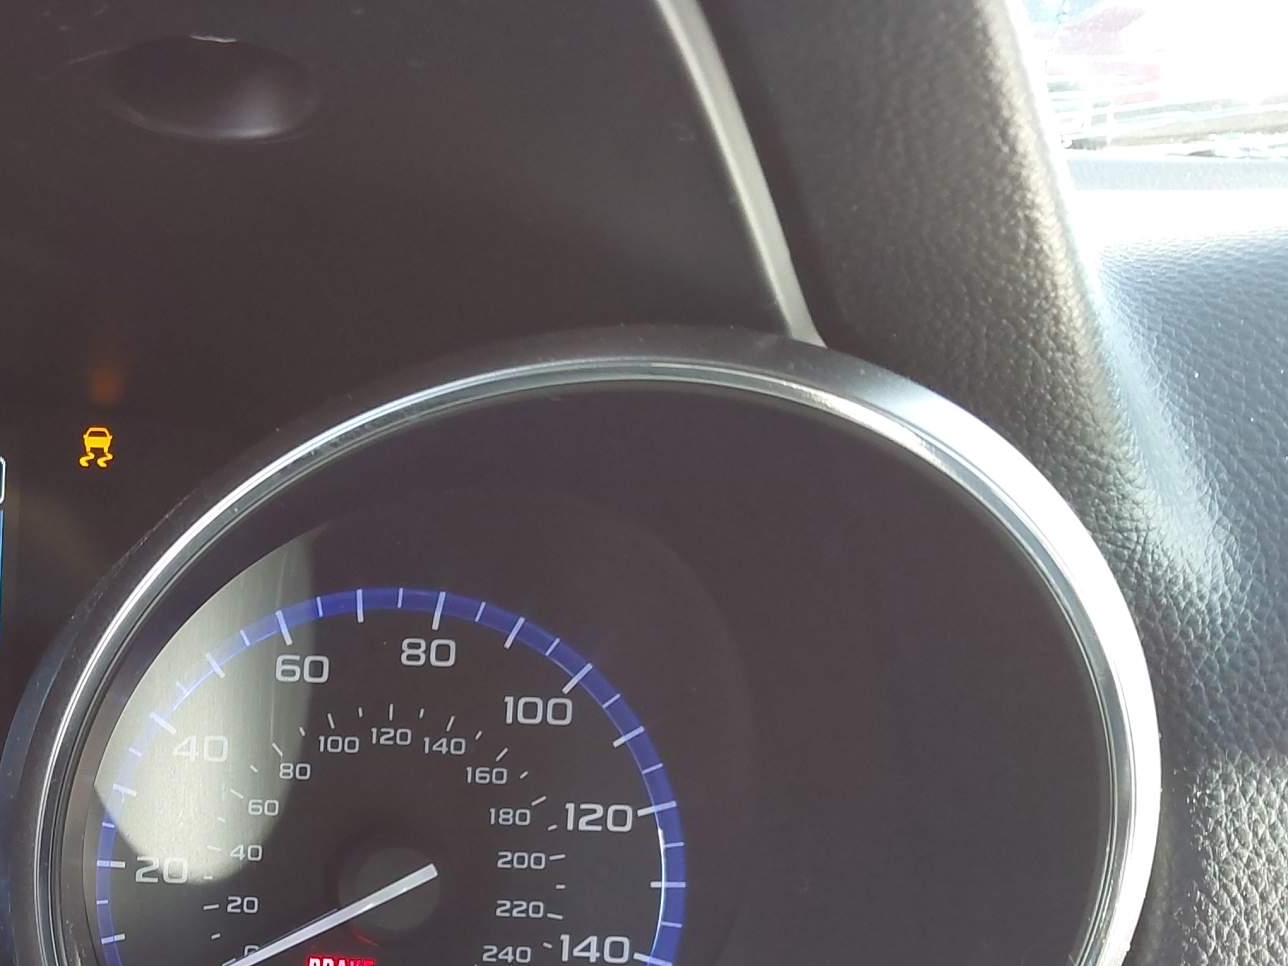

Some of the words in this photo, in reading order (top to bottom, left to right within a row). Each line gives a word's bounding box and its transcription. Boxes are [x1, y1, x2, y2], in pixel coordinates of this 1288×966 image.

[400, 639, 456, 667] 80
[275, 655, 329, 683] 60
[504, 696, 572, 726] 100
[318, 735, 359, 753] 100
[371, 728, 411, 746] 120
[424, 737, 466, 755] 140
[173, 735, 229, 762] 40
[279, 763, 310, 780] 80
[466, 767, 507, 785] 160
[248, 799, 279, 816] 60
[489, 808, 530, 826] 180
[565, 803, 633, 832] 120
[230, 845, 262, 862] 40
[497, 852, 545, 869] 200
[135, 858, 187, 883] 20
[227, 897, 258, 913] 20
[495, 901, 543, 918] 220
[482, 945, 531, 963] 240
[559, 935, 629, 963] 140
